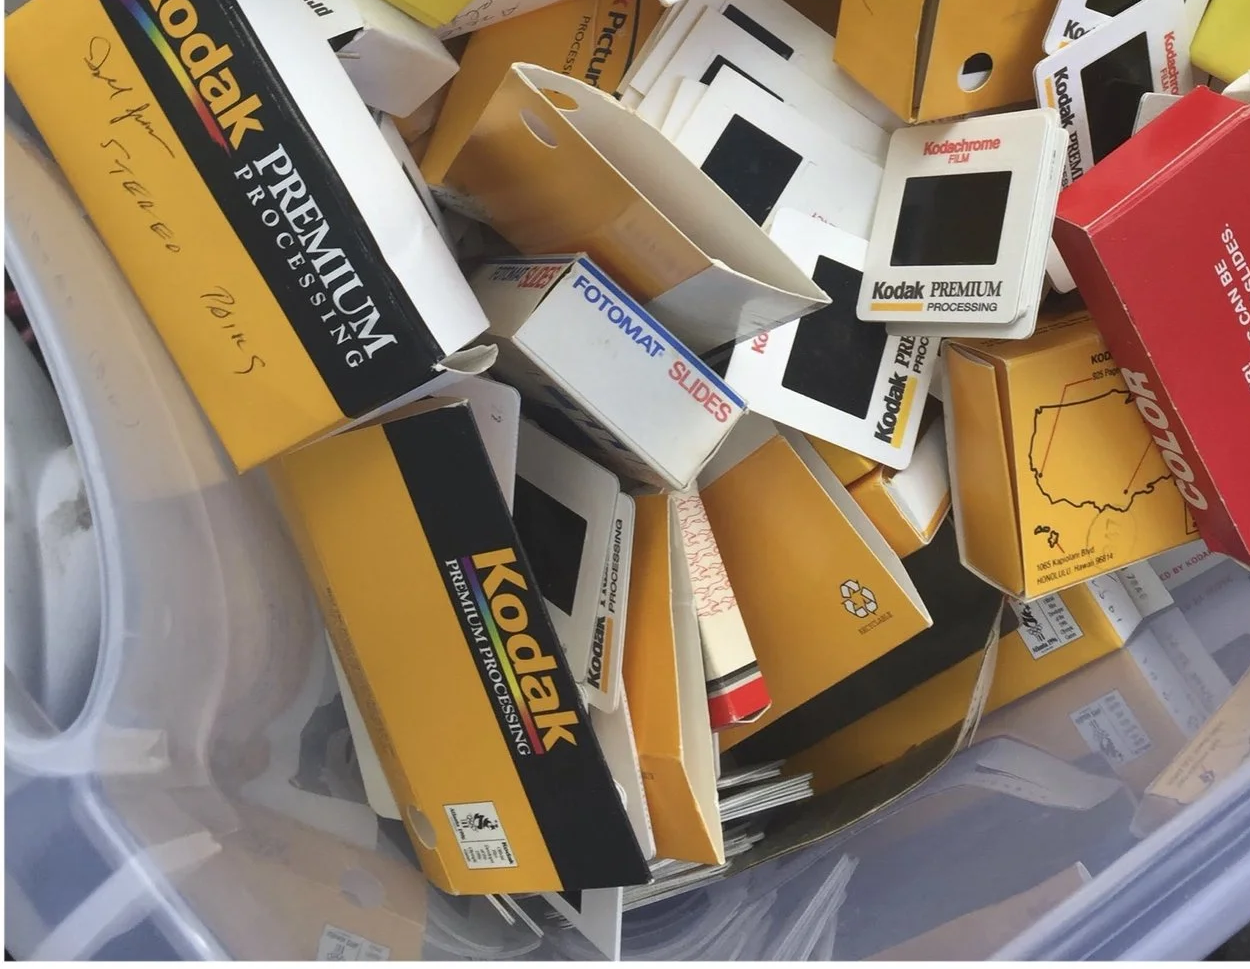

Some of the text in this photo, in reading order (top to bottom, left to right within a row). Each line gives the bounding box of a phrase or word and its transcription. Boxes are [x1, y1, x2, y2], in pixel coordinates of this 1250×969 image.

[585, 11, 628, 87] Pictur
[1160, 67, 1169, 91] FILM
[1164, 30, 1180, 95] Kodachro
[923, 137, 1001, 156] Kodachrome
[1054, 66, 1084, 181] Kodak PREMI
[948, 153, 970, 164] FILM
[234, 164, 364, 369] PROCESSING
[252, 143, 398, 359] PREMIUM
[1214, 259, 1234, 287] BE
[872, 280, 1003, 299] Kodak PREMIUM
[927, 302, 998, 312] PROCESSING
[1227, 287, 1250, 325] CAN
[573, 275, 732, 423] FOTOMAT SLIDES
[1091, 351, 1113, 364] KOD
[874, 371, 908, 444] Kodak
[1122, 368, 1207, 510] COLOR
[608, 518, 623, 614] PROCESSING
[1037, 552, 1114, 585] HONOLULU Hawaii 96814
[1052, 552, 1080, 568] Kapiolani
[444, 558, 532, 756] PREMIUM PROCESSING
[471, 547, 579, 751] Kodak
